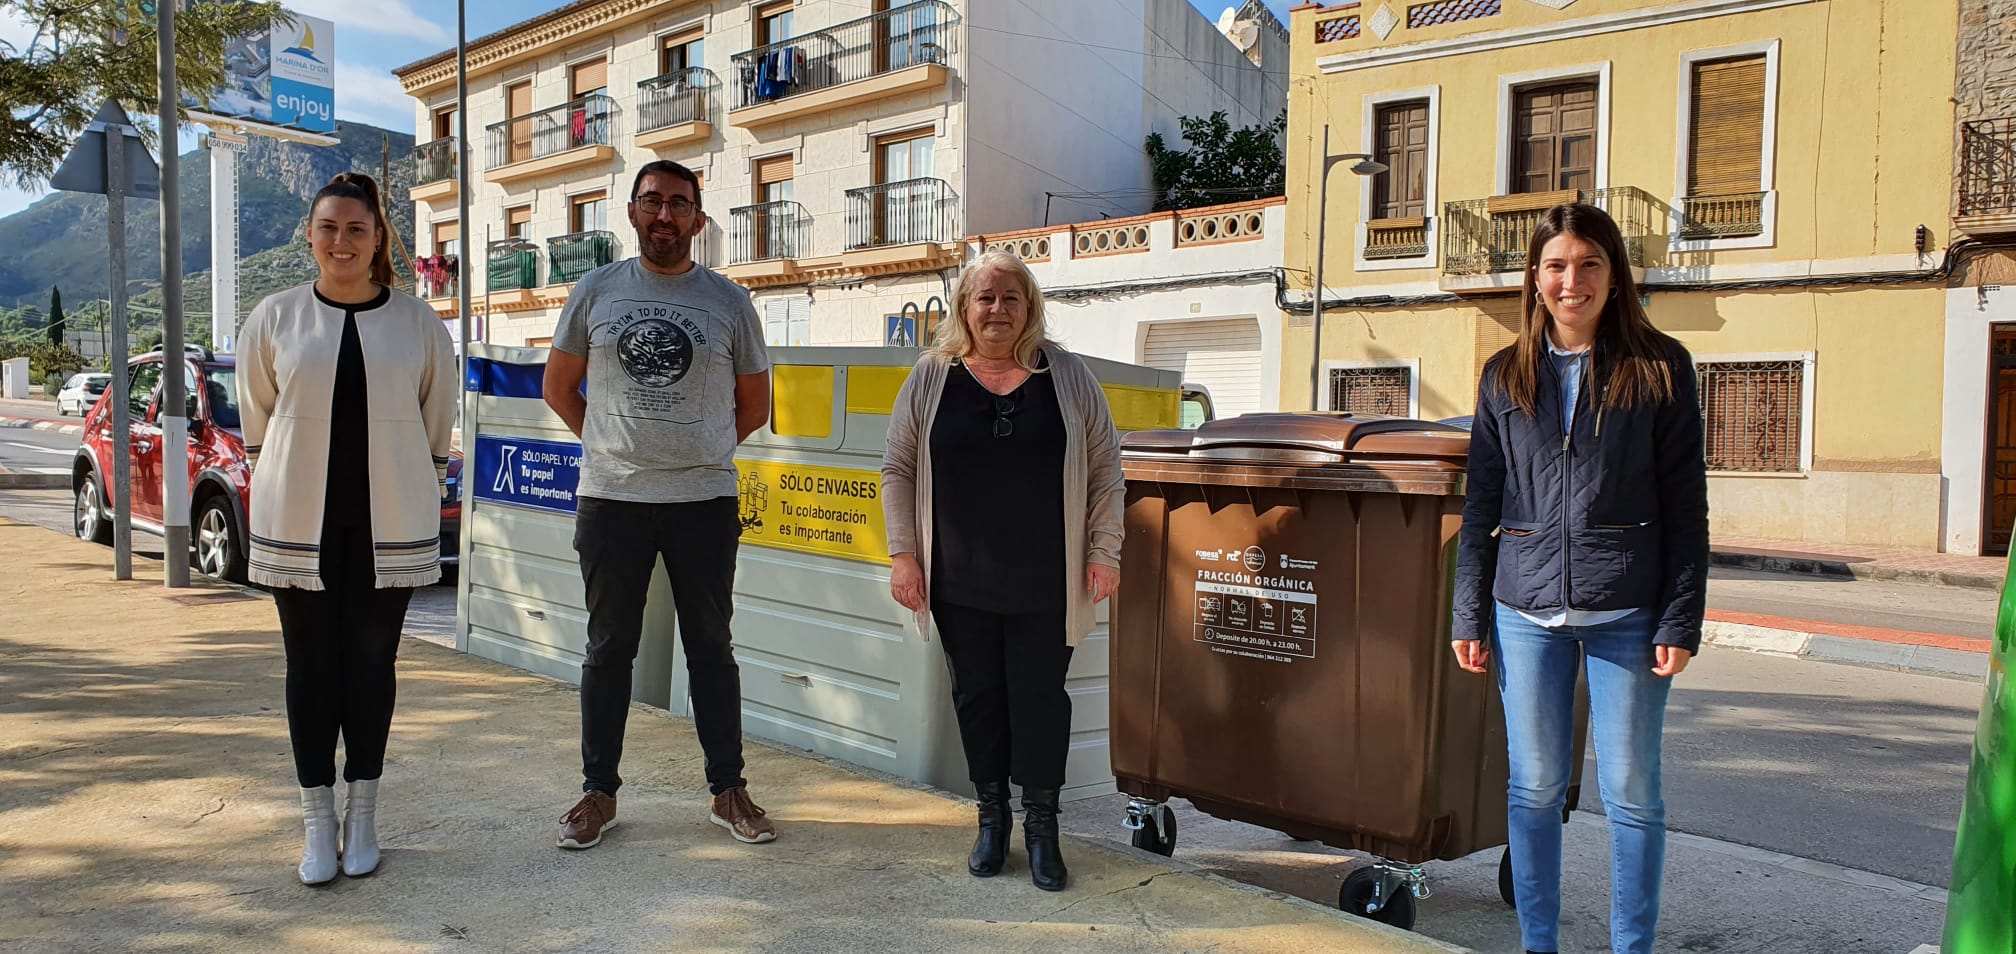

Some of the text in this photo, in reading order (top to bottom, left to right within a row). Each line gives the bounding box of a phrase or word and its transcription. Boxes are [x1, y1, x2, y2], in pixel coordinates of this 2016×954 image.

[275, 56, 329, 74] MARINA D'OR
[276, 93, 330, 121] enjoy
[637, 307, 650, 318] TO
[654, 307, 667, 317] DO
[668, 311, 682, 321] IT
[681, 318, 707, 346] BETTER
[522, 449, 540, 463] SÓLO
[541, 453, 561, 465] PAPEL
[563, 455, 568, 465] Y
[521, 465, 554, 482] Tu papel
[520, 484, 572, 500] es importante
[780, 471, 877, 499] SÓLO ENVASES
[781, 500, 867, 525] Tu colaboración
[779, 523, 853, 545] es importante
[1198, 569, 1314, 591] FRACCIÓN ORGÁNICA
[1213, 585, 1250, 594] NORMAS
[1271, 591, 1289, 599] USO
[1215, 632, 1241, 643] Deposite
[1240, 635, 1249, 643] de
[1248, 637, 1266, 646] 20.00
[1265, 639, 1272, 647] h.
[1278, 641, 1295, 650] 23.00
[1295, 643, 1302, 651] h.
